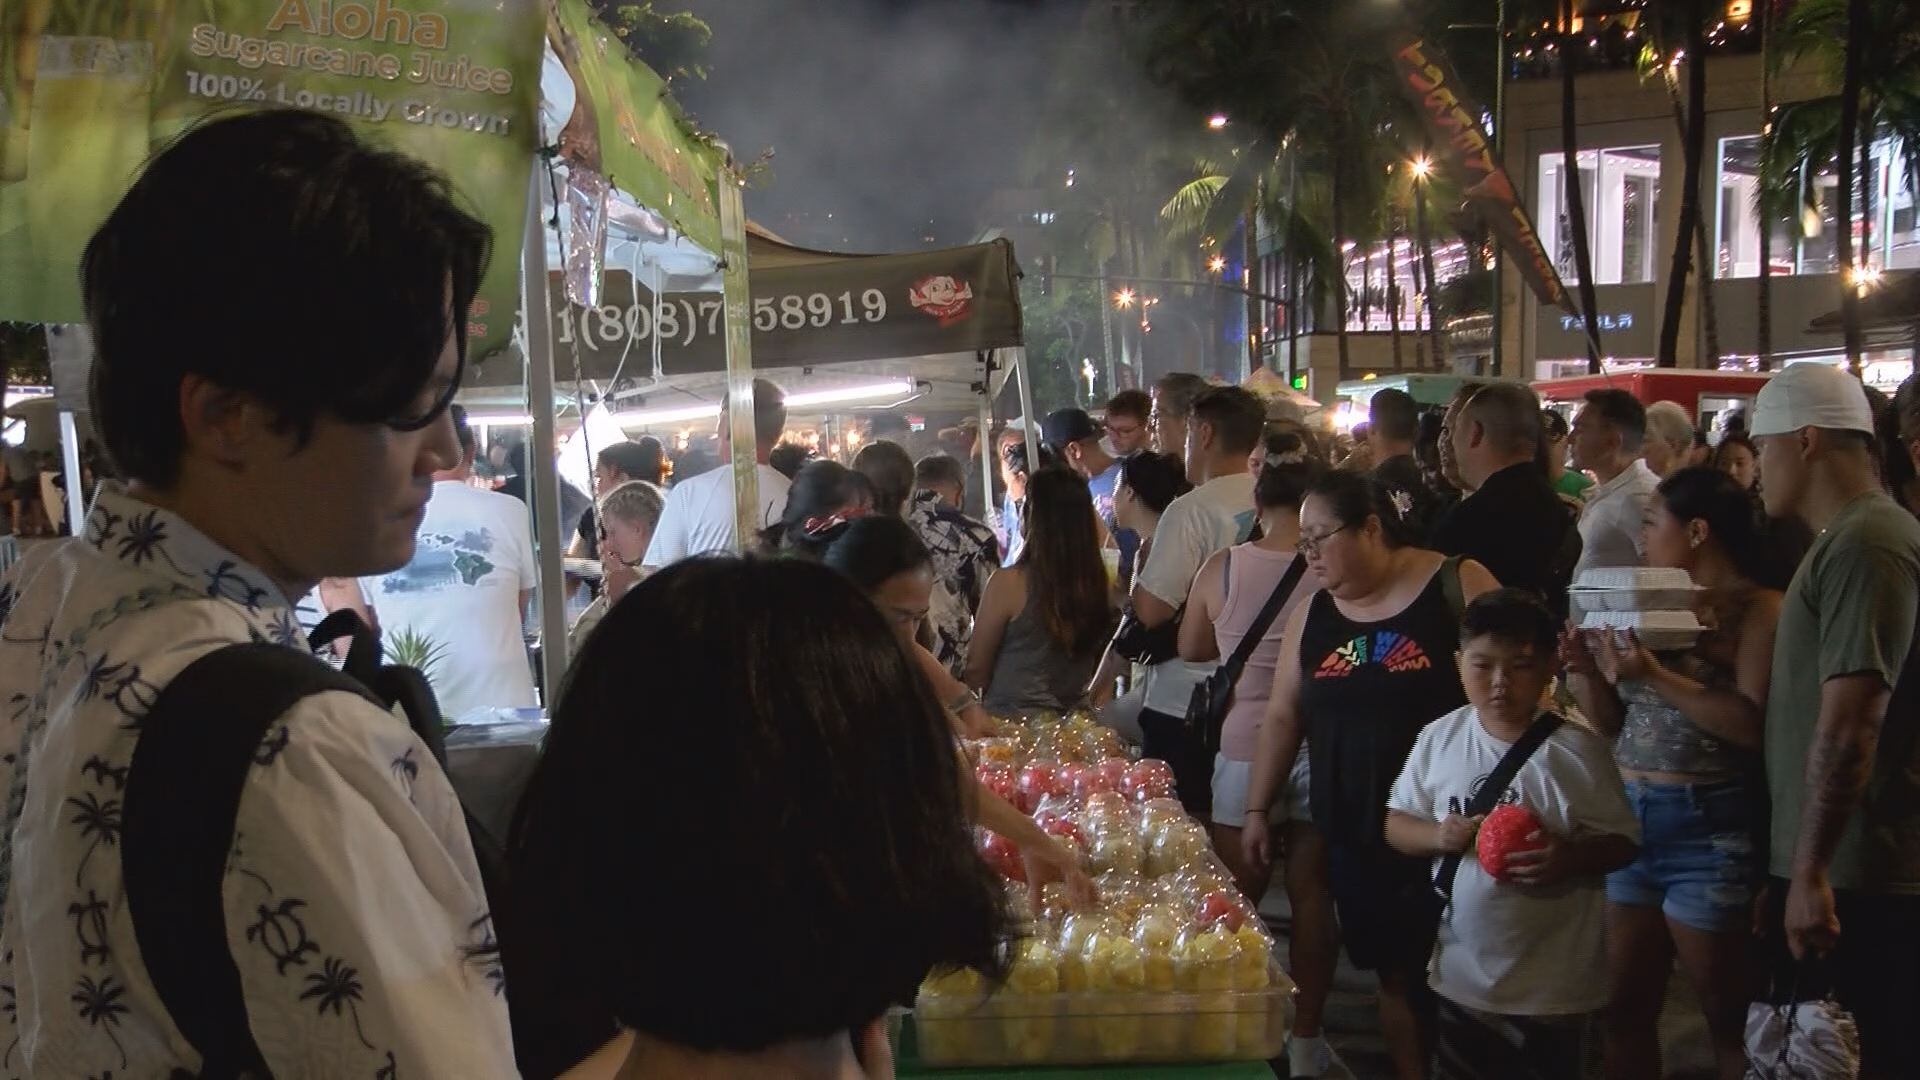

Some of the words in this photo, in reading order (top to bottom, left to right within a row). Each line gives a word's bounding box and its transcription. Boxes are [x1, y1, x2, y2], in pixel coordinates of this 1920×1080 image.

[265, 0, 449, 49] Aloha
[191, 23, 400, 80] Sugarcane
[407, 51, 513, 94] Juice
[186, 71, 265, 101] 100%
[277, 81, 393, 121] Locally
[402, 97, 510, 135] Grown
[557, 288, 888, 351] 1(808)758919
